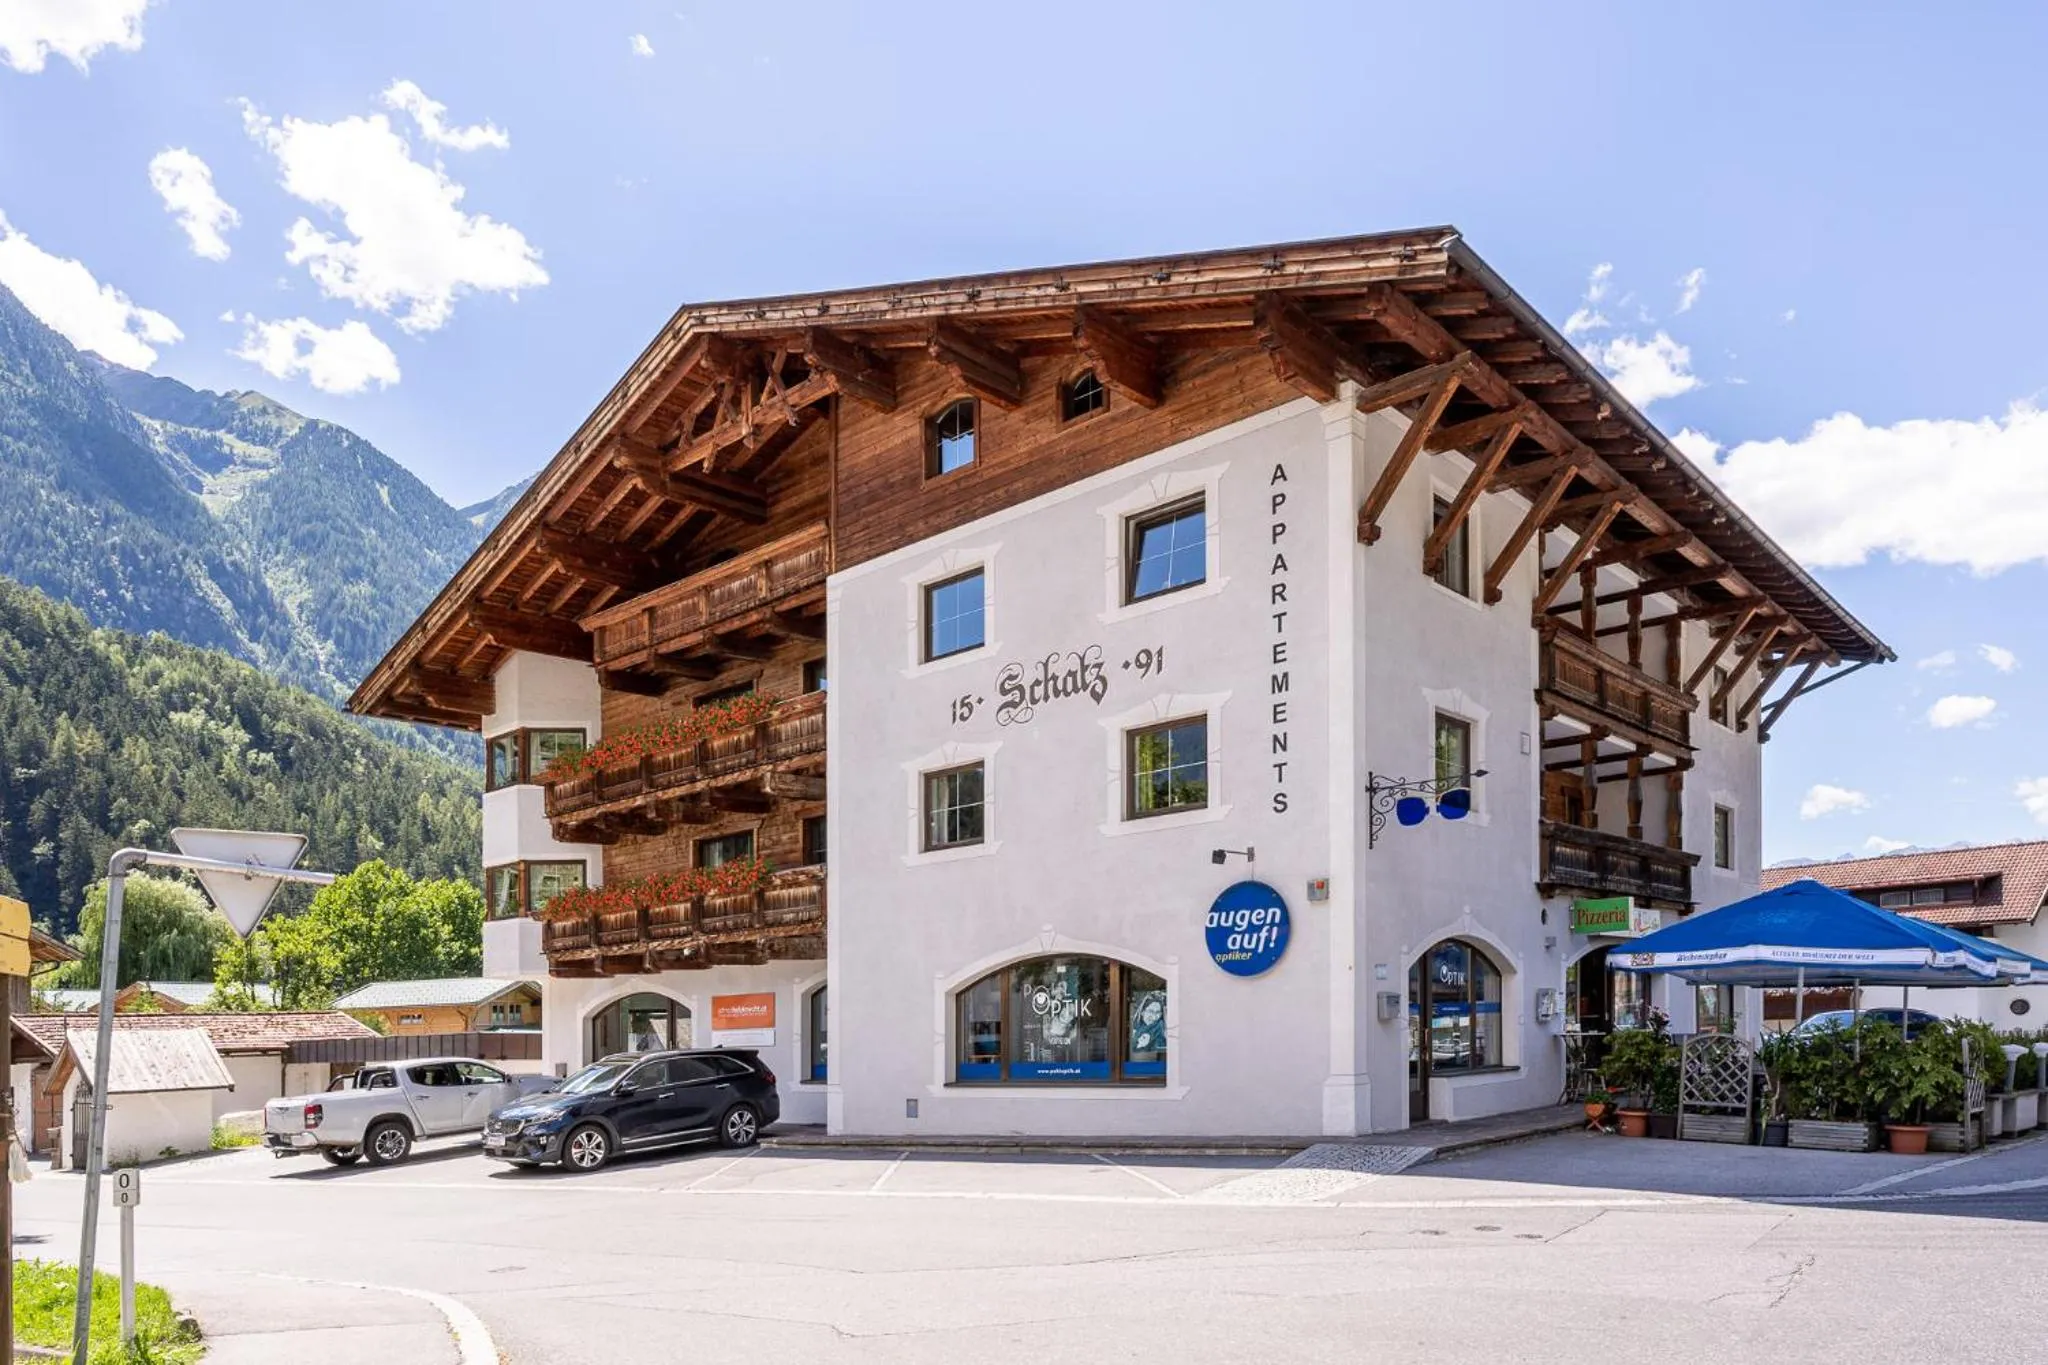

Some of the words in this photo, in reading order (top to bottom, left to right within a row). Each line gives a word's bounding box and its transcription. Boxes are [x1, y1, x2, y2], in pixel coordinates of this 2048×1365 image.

[1271, 463, 1290, 813] APPARTEMENTS
[995, 643, 1109, 727] Schatz
[1205, 907, 1281, 932] augen
[1576, 906, 1626, 927] Pizzeria
[1227, 926, 1279, 953] auf!
[1215, 950, 1253, 964] optiker
[1032, 992, 1092, 1017] OPTIK
[119, 1173, 130, 1189] 0
